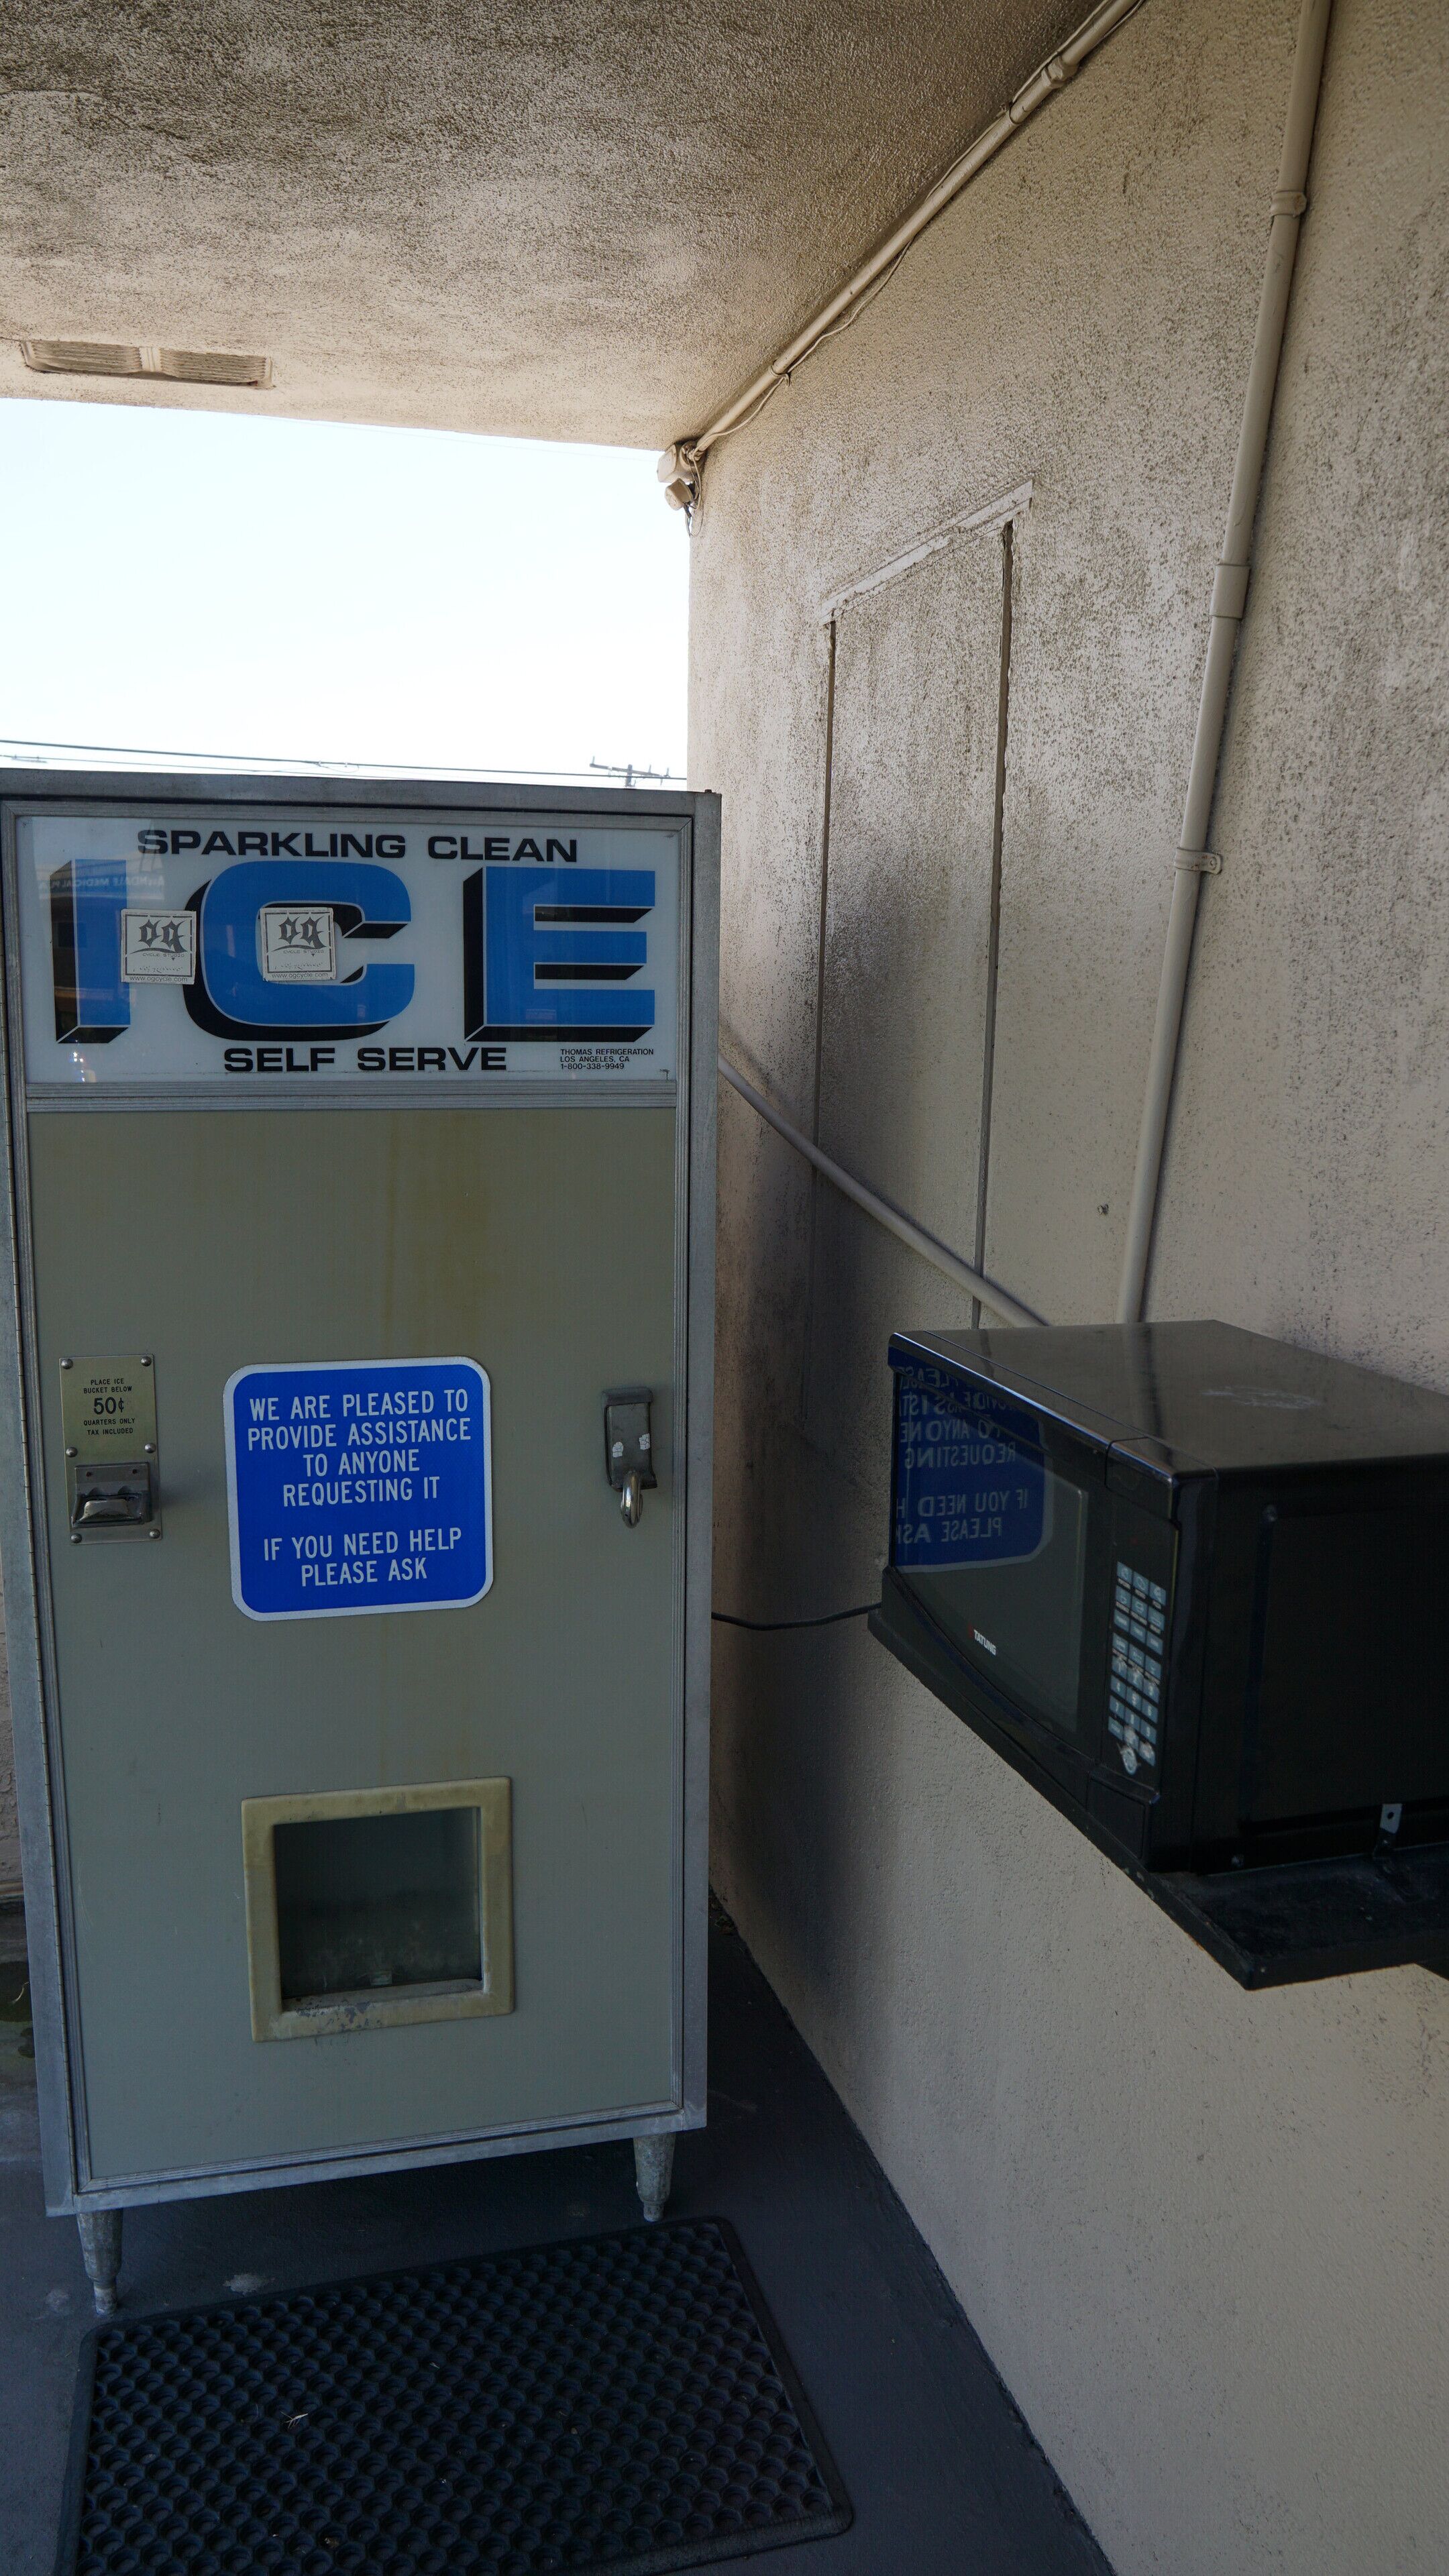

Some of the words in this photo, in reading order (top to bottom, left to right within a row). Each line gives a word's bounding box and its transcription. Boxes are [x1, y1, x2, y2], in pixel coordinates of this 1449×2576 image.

[138, 829, 406, 859] SPARKLING
[427, 835, 578, 863] CLEAN
[50, 859, 655, 1044] ICE
[223, 1047, 335, 1073] SELF
[357, 1046, 506, 1071] SERVE
[93, 1397, 124, 1415] 50¢
[250, 1397, 279, 1421] WE
[290, 1395, 331, 1419] ARE
[343, 1391, 434, 1417] PLEASED
[444, 1389, 468, 1412] TO
[84, 1418, 116, 1426] QUARTERS
[248, 1424, 337, 1450] PROVIDE
[348, 1418, 471, 1446] ASSISTANCE
[303, 1454, 327, 1477] TO
[339, 1449, 420, 1475] ANYONE
[283, 1478, 413, 1507] REQUESTING
[424, 1477, 440, 1499] IT
[264, 1538, 282, 1560] IF
[291, 1535, 332, 1559] YOU
[344, 1531, 398, 1556] NEED
[409, 1527, 462, 1552] HELP
[301, 1560, 378, 1587] PLEASE
[388, 1557, 427, 1580] ASK
